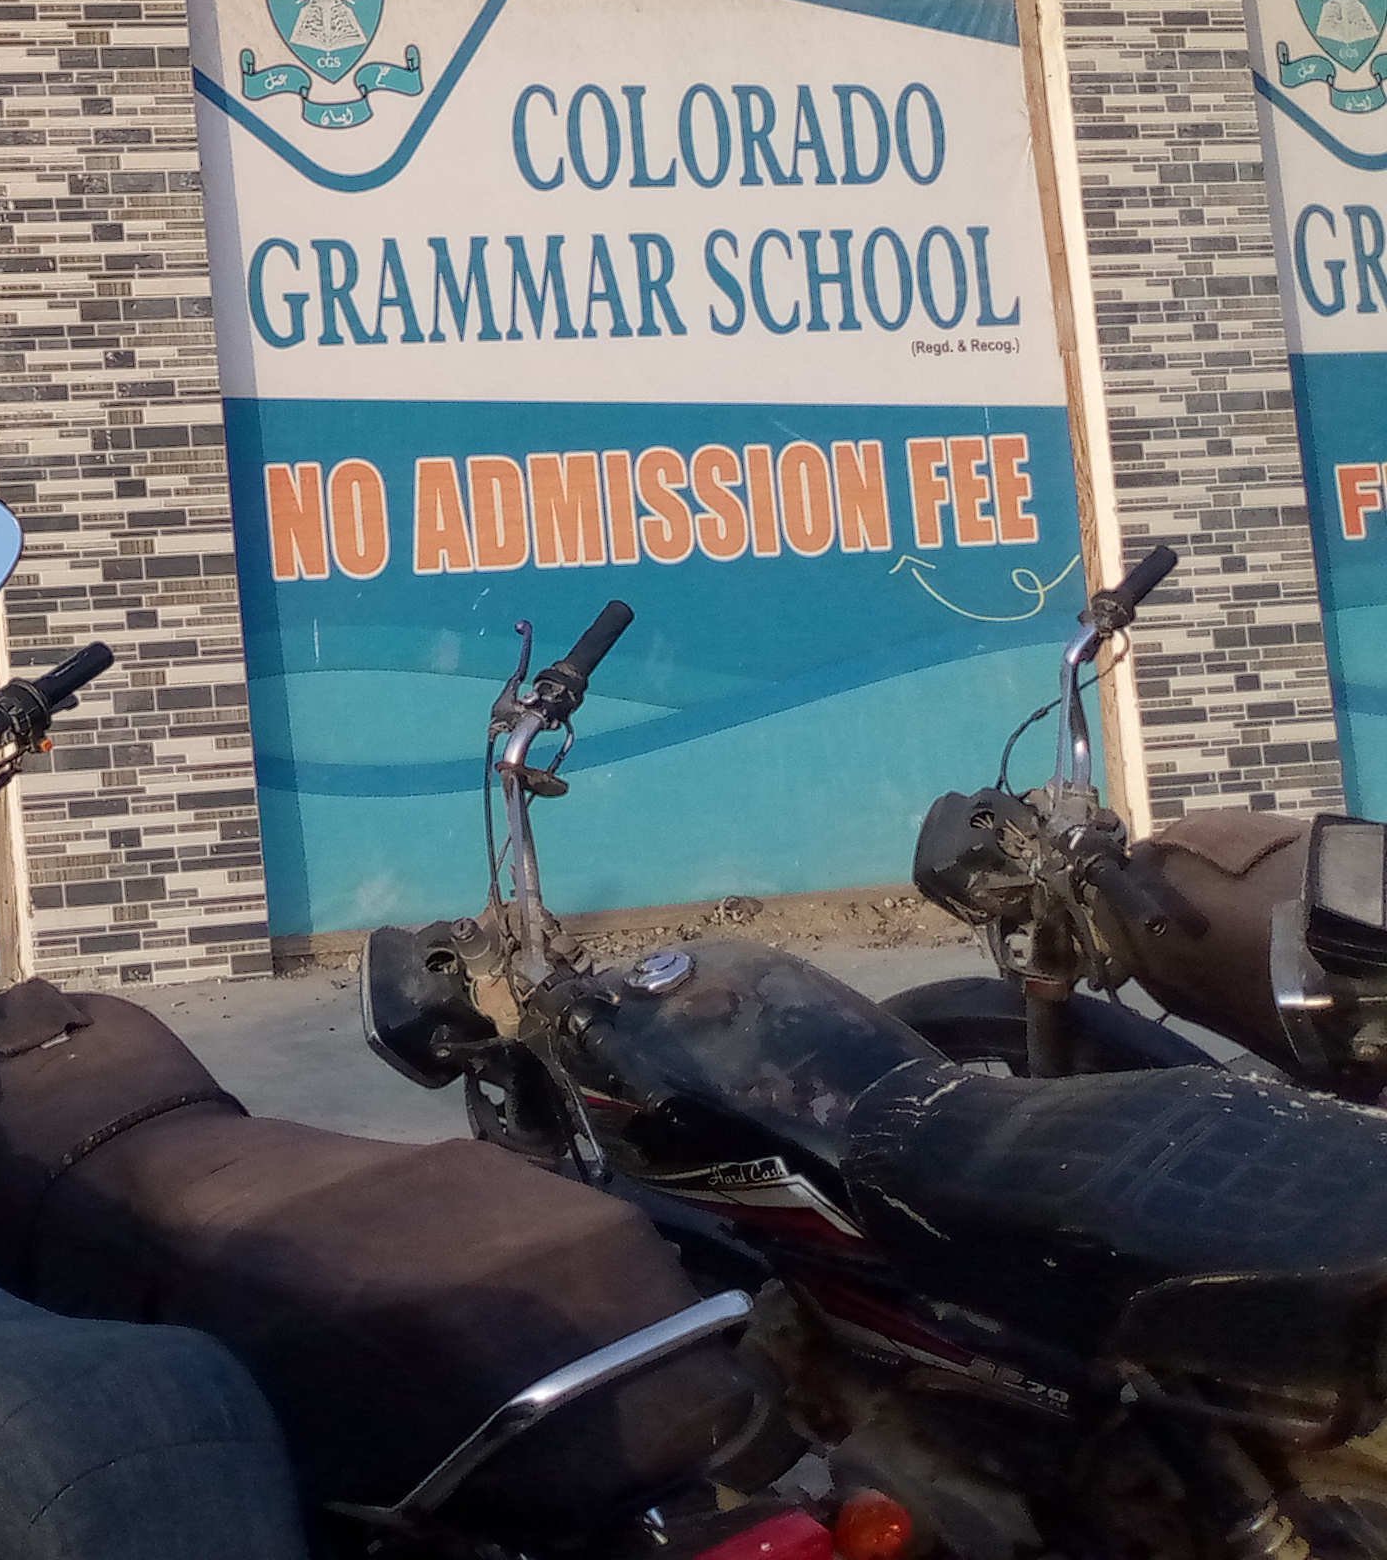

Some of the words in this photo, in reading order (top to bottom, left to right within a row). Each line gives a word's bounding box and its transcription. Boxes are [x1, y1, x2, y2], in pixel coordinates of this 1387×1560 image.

[317, 57, 341, 69] CGS
[513, 82, 946, 191] COLORADO
[249, 233, 688, 349] GRAMMAR
[704, 225, 1021, 336] SCHOOL
[911, 340, 954, 358] (Regd.
[957, 339, 967, 353] &
[970, 337, 1020, 355] Recog.)
[263, 458, 389, 581] NO
[413, 441, 893, 576] ADMISSION
[906, 434, 1039, 550] FEE
[1334, 462, 1387, 540] F
